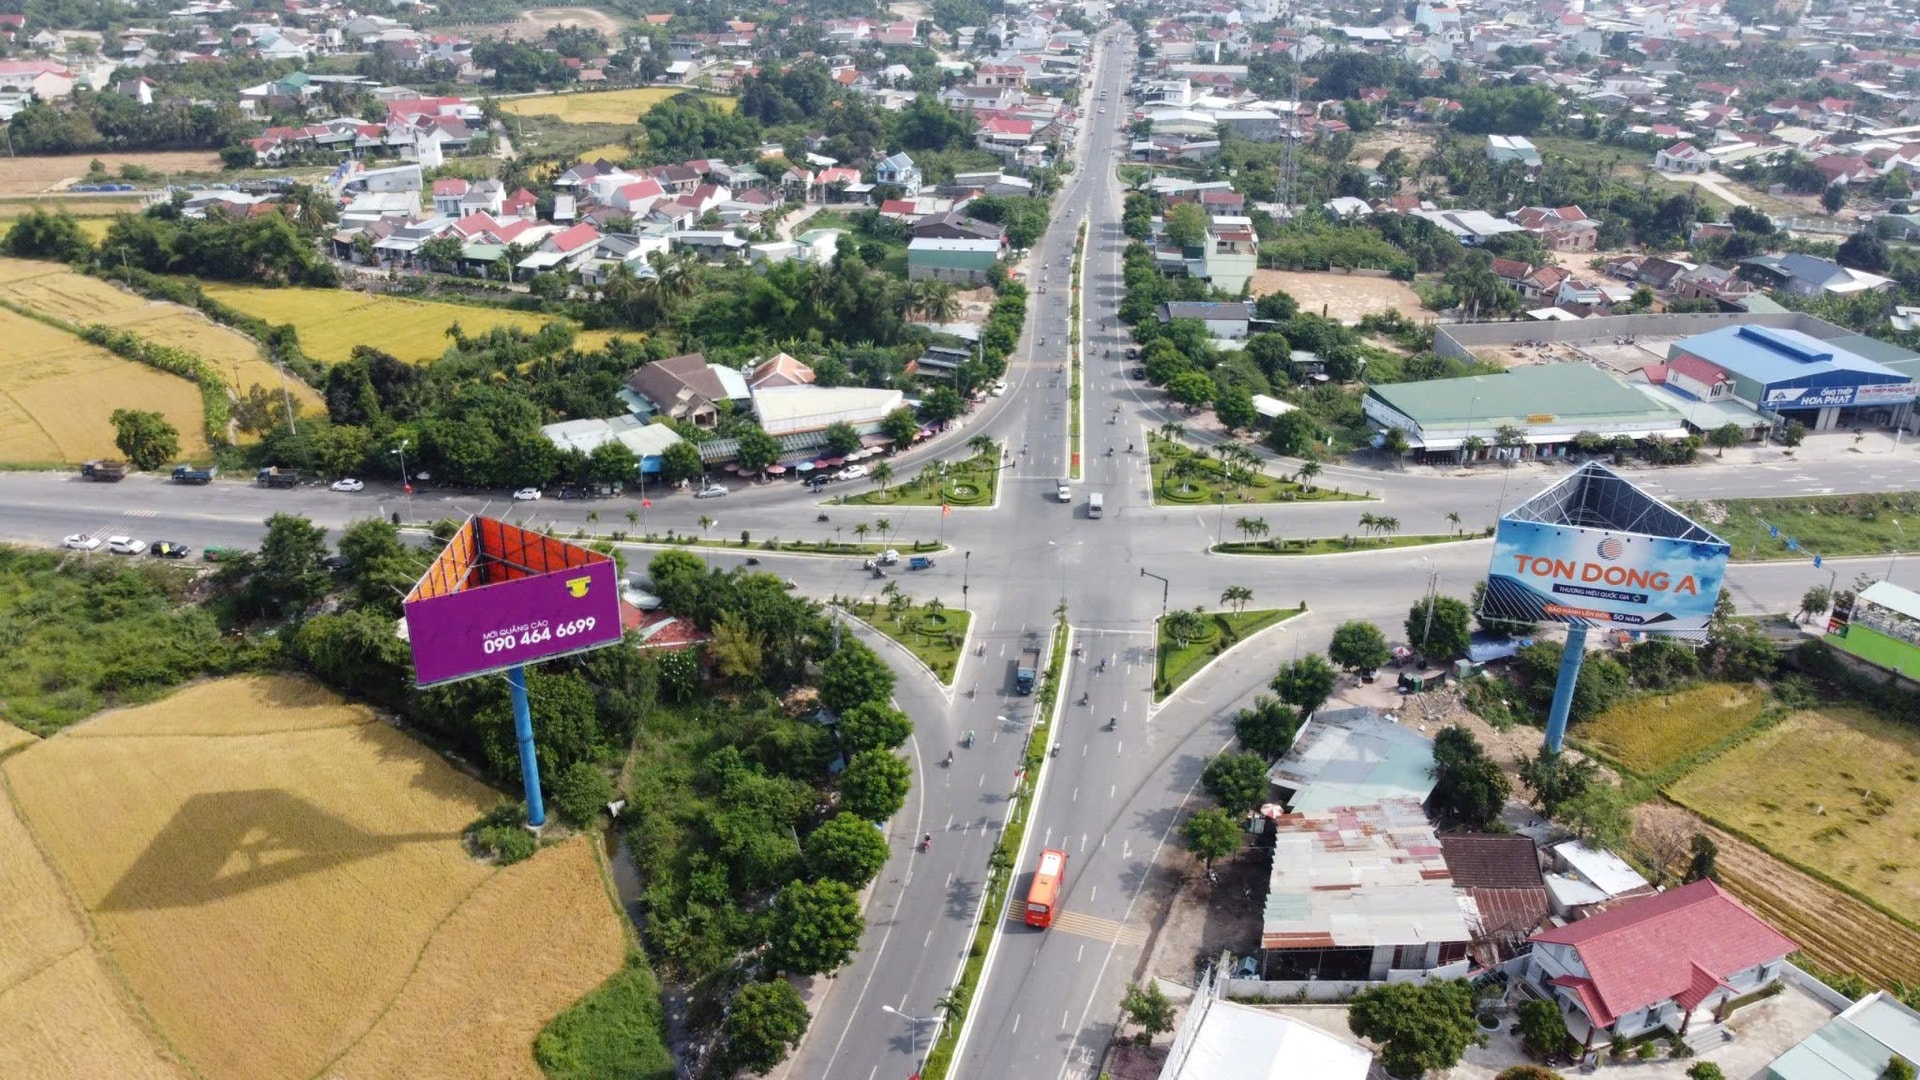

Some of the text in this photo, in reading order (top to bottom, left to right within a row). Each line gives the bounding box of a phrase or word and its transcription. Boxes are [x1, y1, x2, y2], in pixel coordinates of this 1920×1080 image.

[1514, 554, 1698, 595] TON DONG A
[1613, 613, 1624, 621] 50
[484, 616, 596, 654] 090 464 6699
[1077, 1046, 1097, 1066] XE
